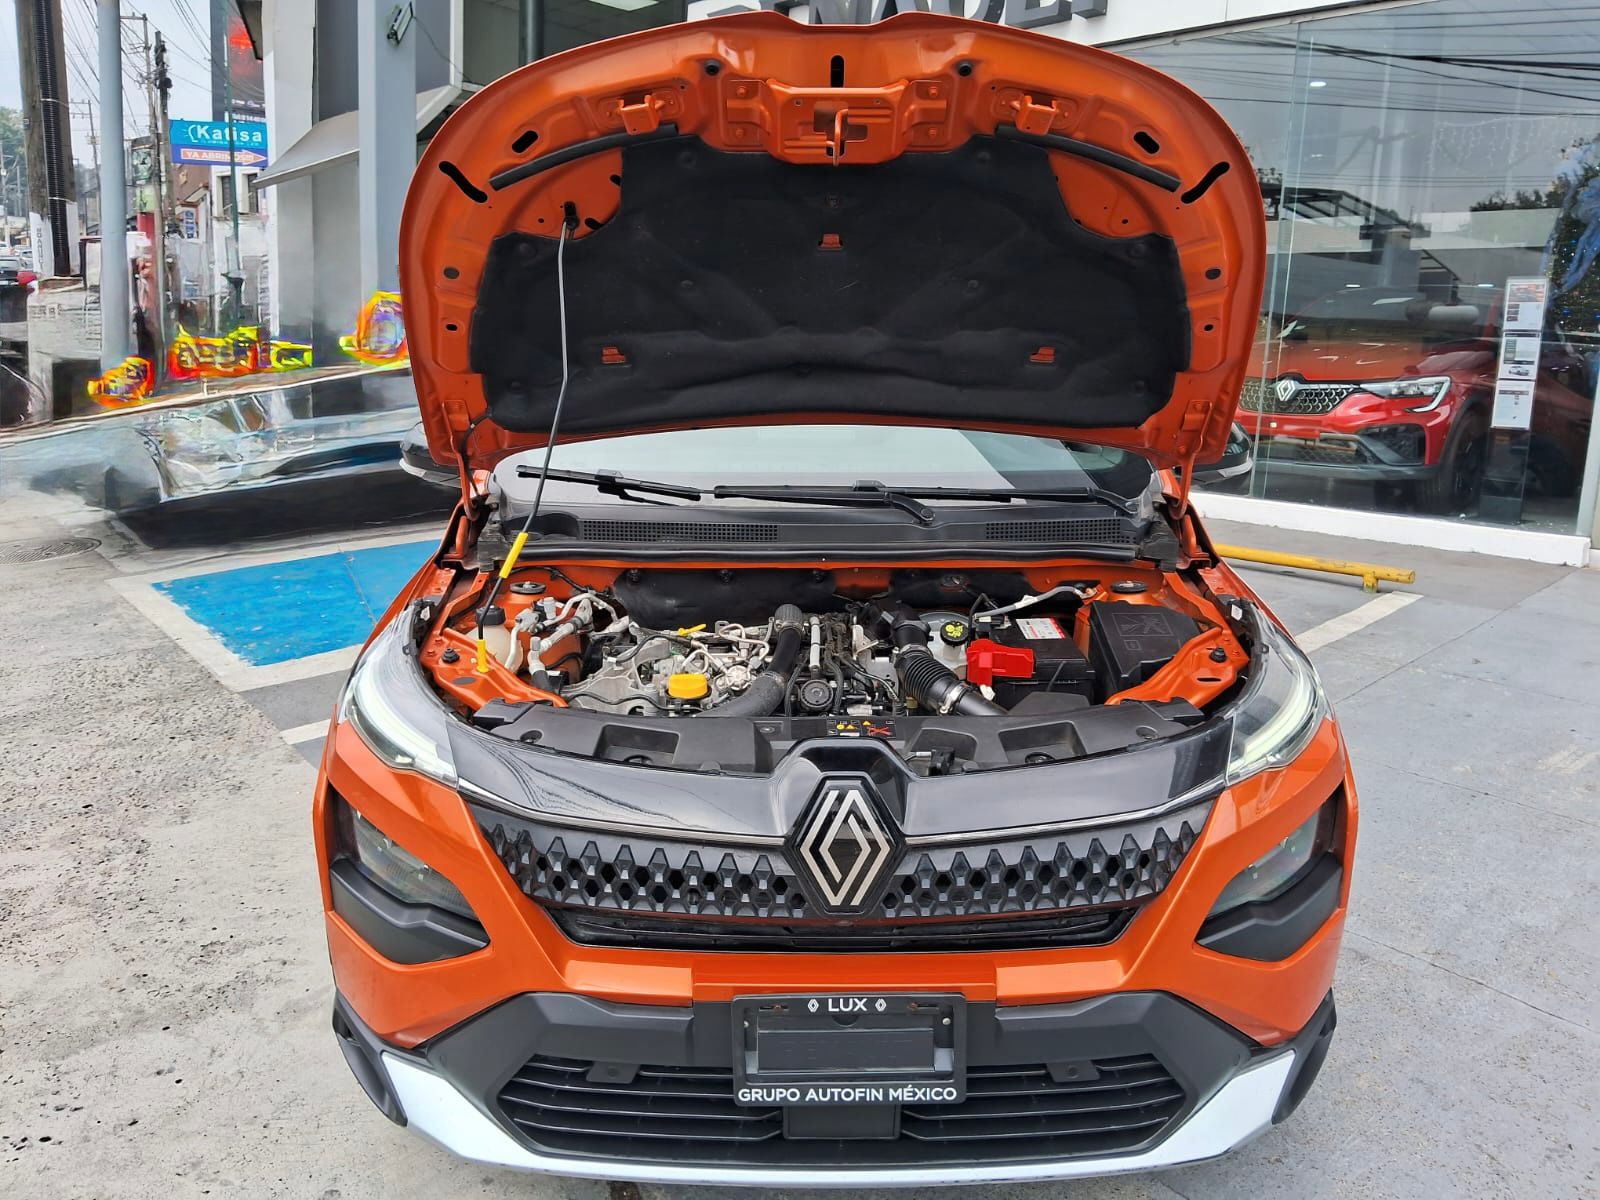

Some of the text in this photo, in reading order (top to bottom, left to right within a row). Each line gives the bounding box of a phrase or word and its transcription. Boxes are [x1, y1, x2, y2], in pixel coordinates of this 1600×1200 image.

[827, 998, 867, 1012] LUX
[738, 1085, 957, 1102] GRUPO AUTOFIN MÉXICO
